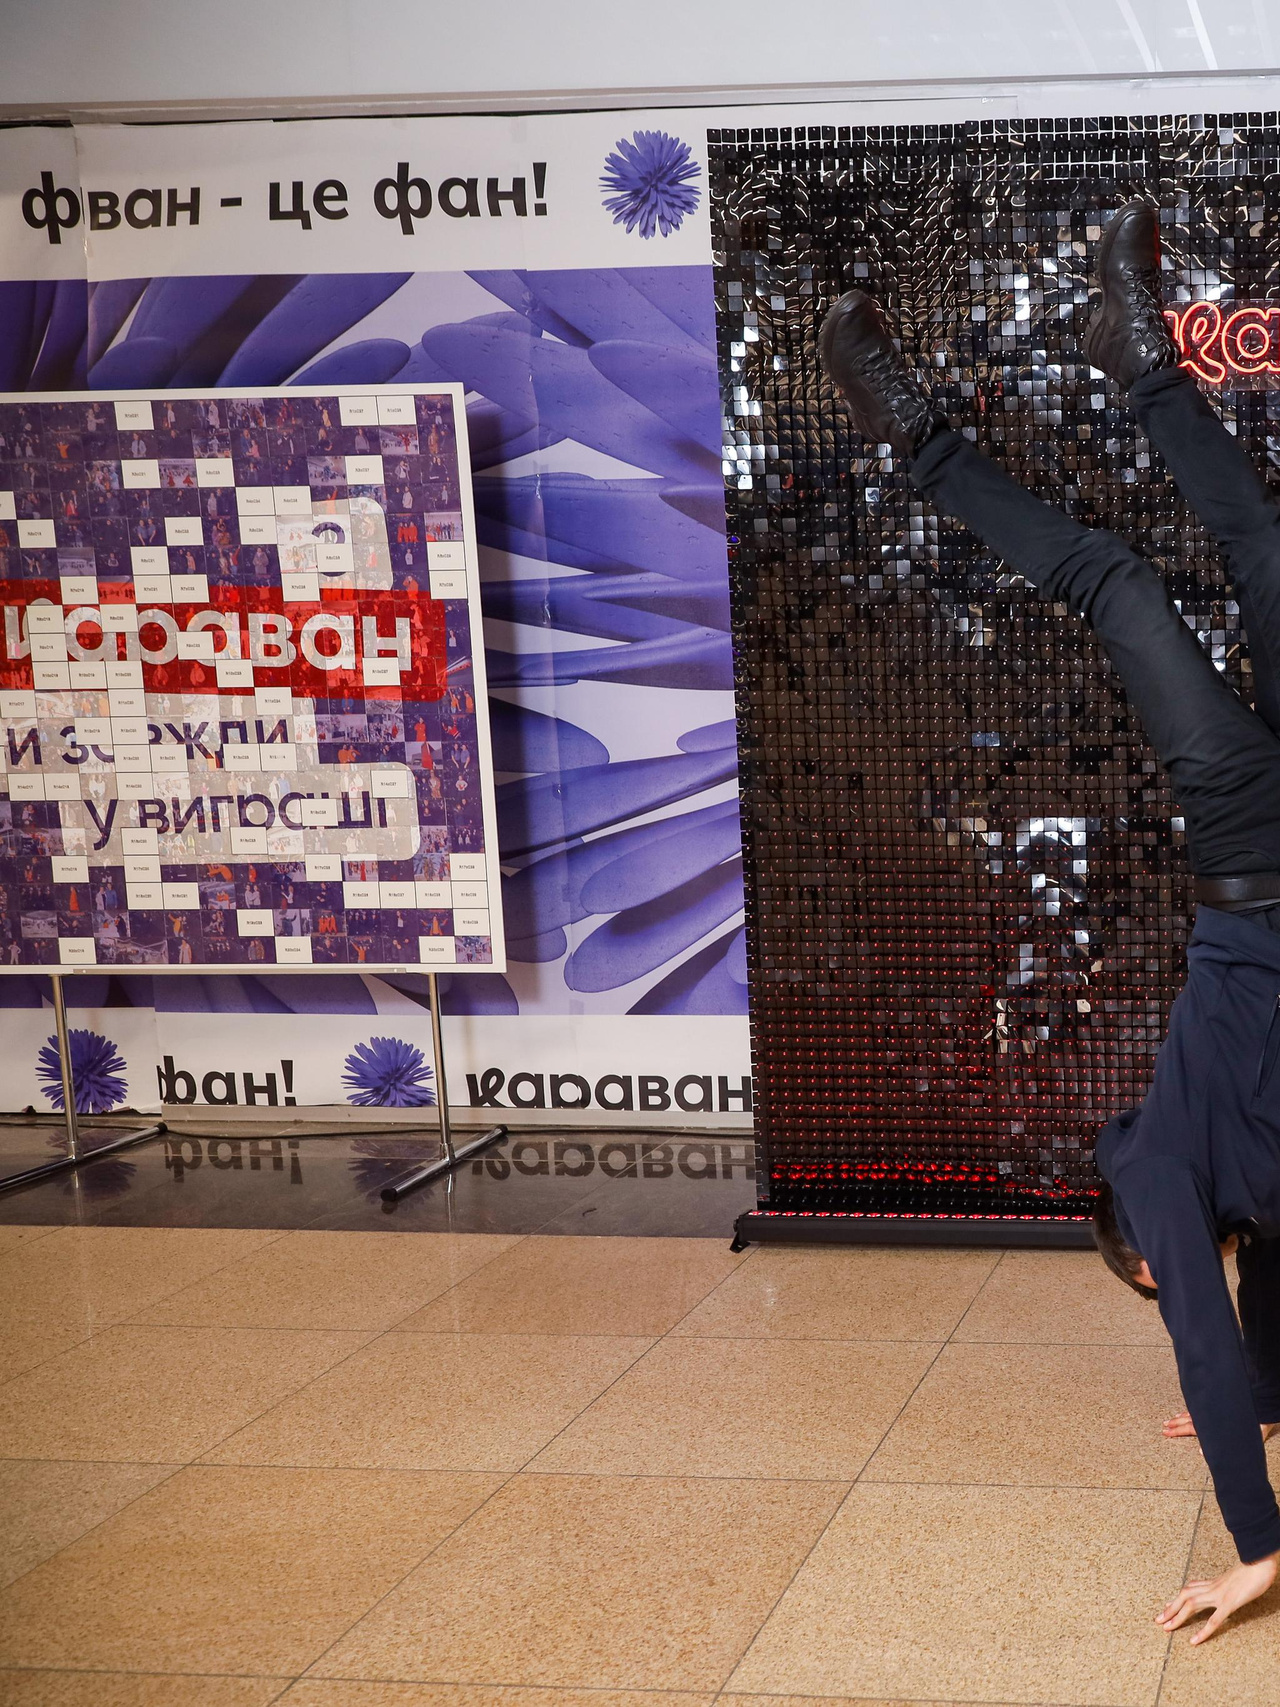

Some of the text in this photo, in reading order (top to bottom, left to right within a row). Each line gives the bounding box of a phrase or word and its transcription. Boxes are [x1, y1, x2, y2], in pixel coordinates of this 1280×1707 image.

[270, 179, 349, 230] це
[374, 162, 548, 235] фан!
[60, 719, 289, 769] зжди
[466, 1067, 752, 1112] караван
